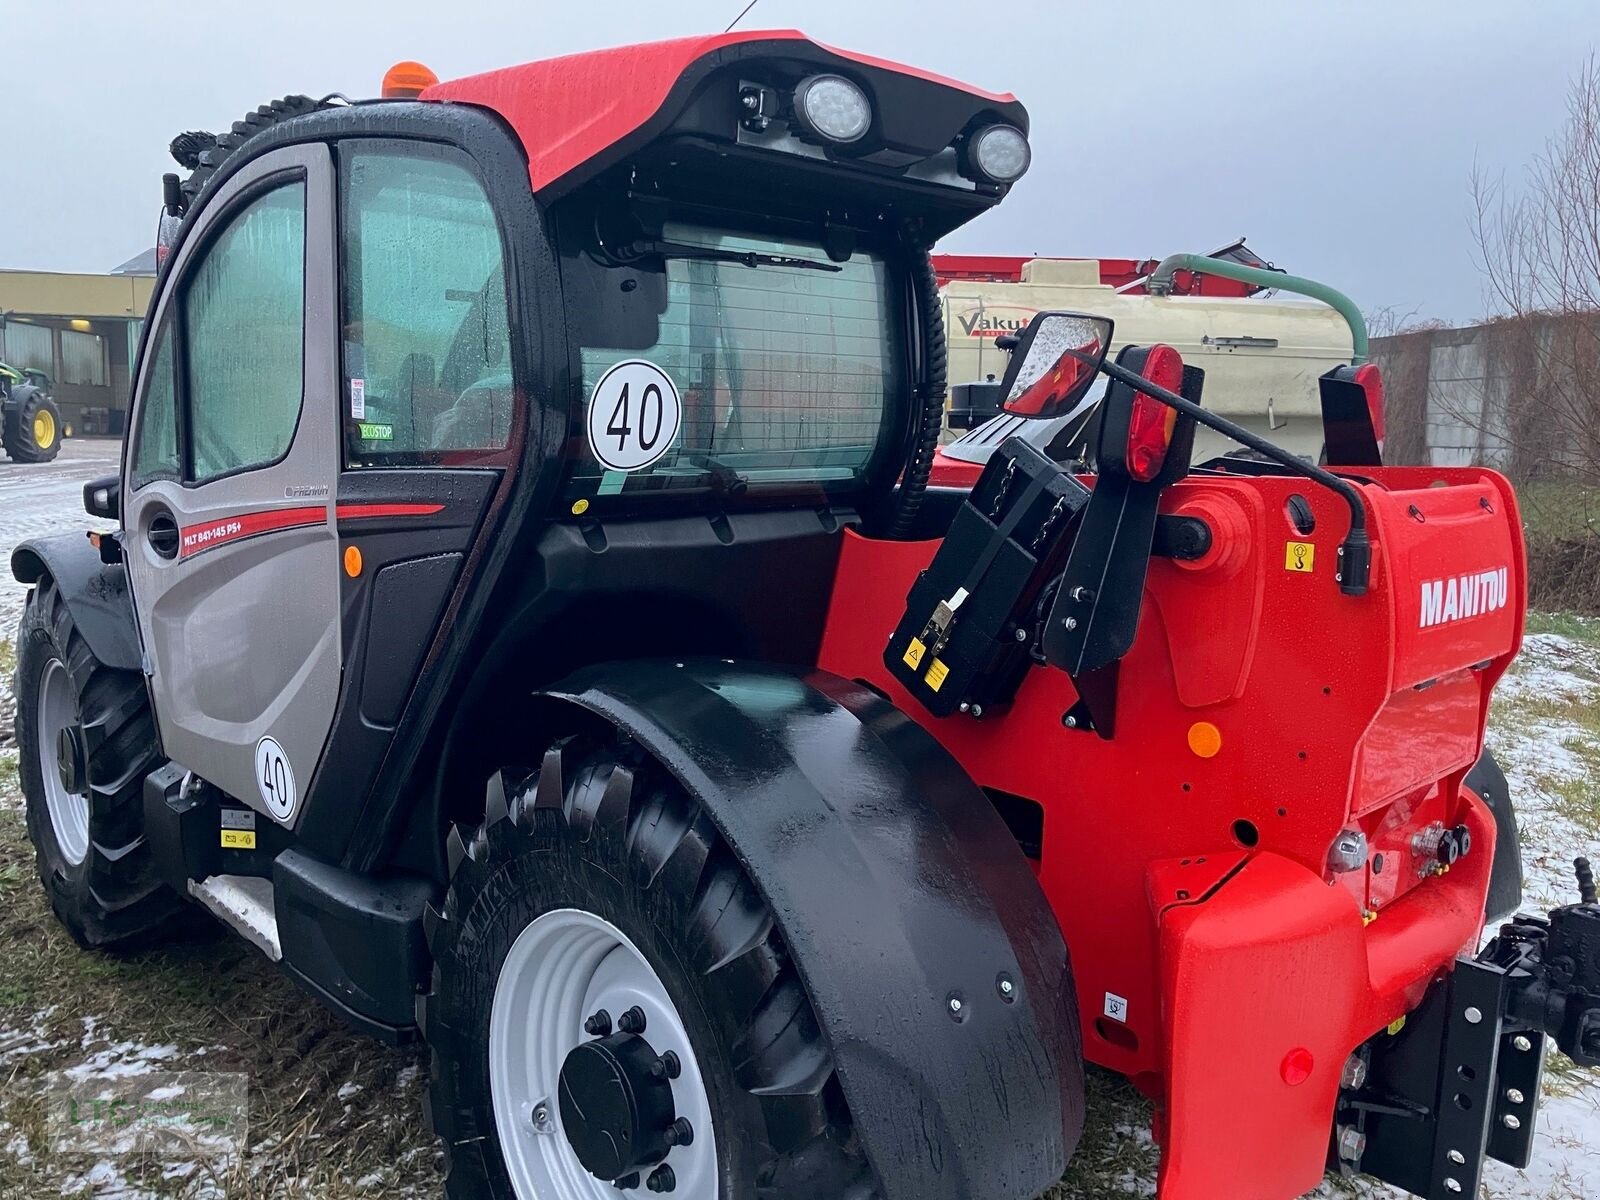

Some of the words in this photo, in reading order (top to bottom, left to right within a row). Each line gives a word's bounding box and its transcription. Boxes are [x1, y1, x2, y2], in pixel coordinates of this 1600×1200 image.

[362, 426, 392, 438] ECOSTOP
[606, 382, 663, 451] 40
[198, 526, 225, 543] 841-145
[226, 521, 242, 535] PS+
[1419, 567, 1507, 628] MANITOU
[264, 752, 287, 807] 40
